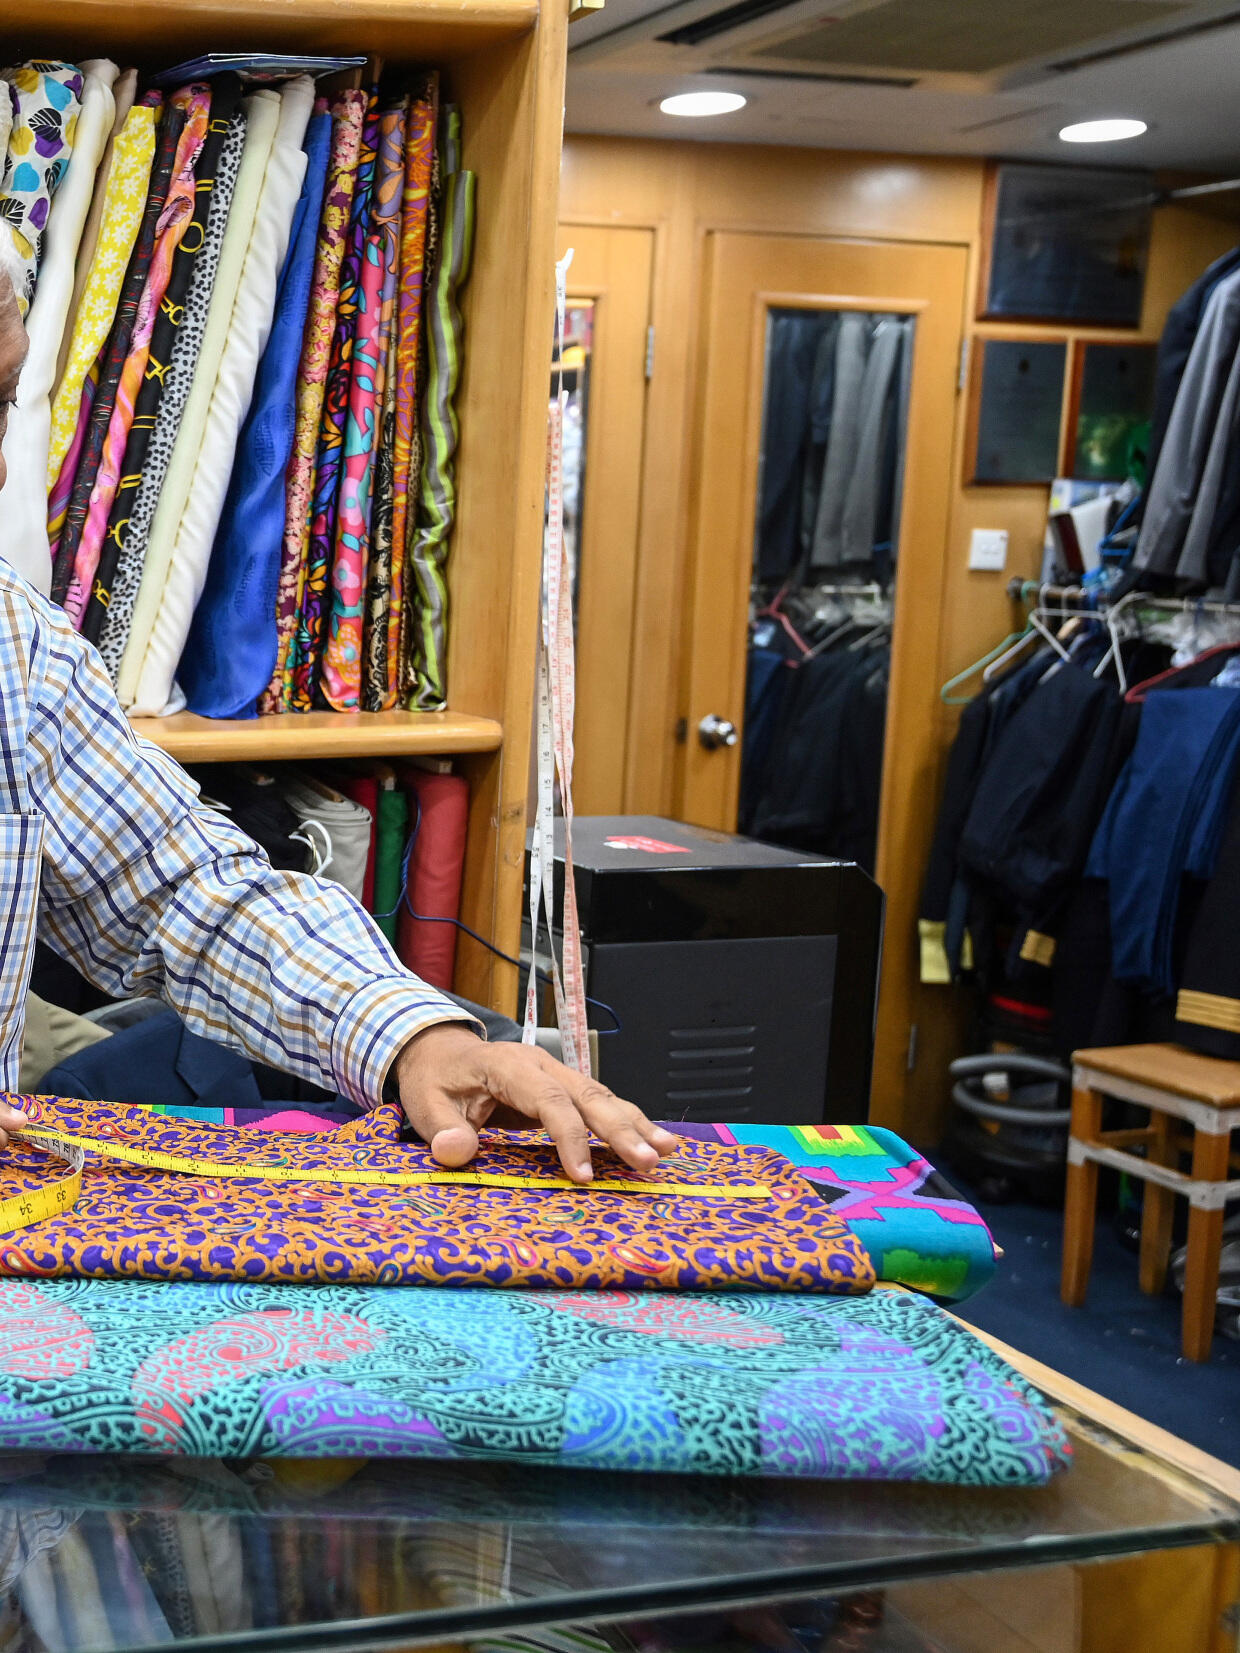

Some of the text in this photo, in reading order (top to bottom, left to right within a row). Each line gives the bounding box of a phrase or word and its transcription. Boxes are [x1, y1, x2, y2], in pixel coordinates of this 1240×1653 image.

[542, 723, 549, 734] 17
[56, 1190, 66, 1202] 33
[19, 1202, 32, 1216] 34
